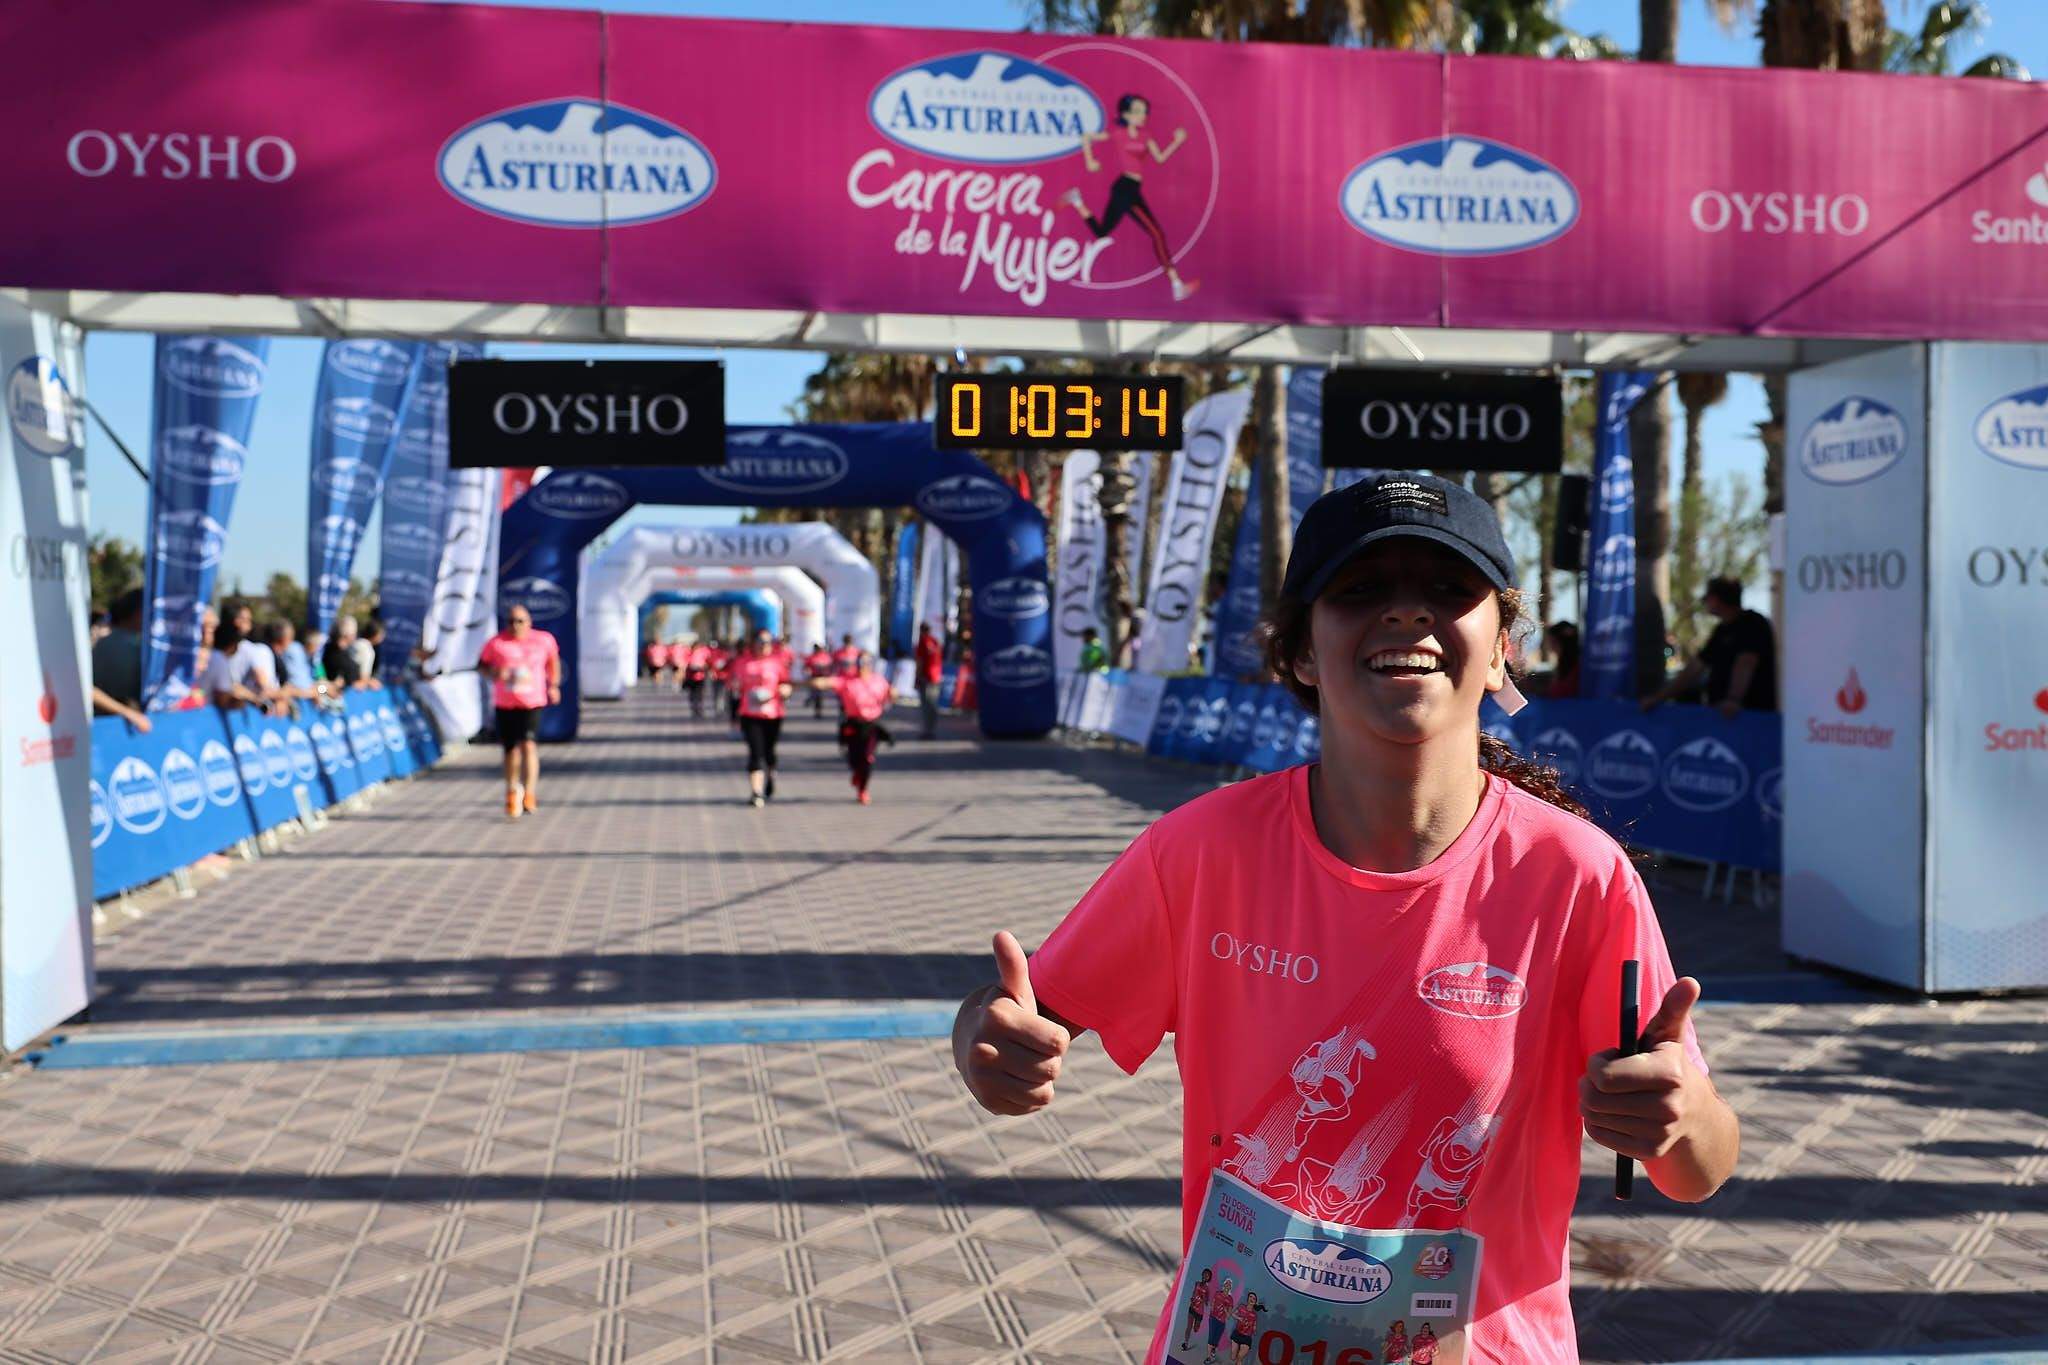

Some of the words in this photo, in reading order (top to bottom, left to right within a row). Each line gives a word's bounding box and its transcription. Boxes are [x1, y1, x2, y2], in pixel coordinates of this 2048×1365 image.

[890, 89, 1085, 136] ASTURIANA
[66, 129, 297, 183] OYSHO
[462, 143, 693, 194] ASTURIANA
[847, 148, 1043, 216] Carrera
[1361, 178, 1558, 223] ASTURIANA
[894, 211, 934, 255] de
[939, 212, 967, 256] la
[1691, 191, 1869, 236] OYSHO
[1971, 209, 2048, 244] Sant
[959, 209, 1114, 307] Mujer
[493, 391, 690, 436] OYSHO
[1360, 400, 1531, 442] OYSHO
[1807, 434, 1899, 465] ASTURIANA
[671, 532, 791, 558] OYSHO
[1798, 548, 1906, 593] OYSHO
[1807, 718, 1893, 749] Santander
[1211, 932, 1319, 984] OYSHO
[1425, 979, 1521, 1006] ASTURIANA
[1218, 1203, 1254, 1235] SUMA
[1269, 1248, 1382, 1293] ASTURIANA
[1291, 1252, 1336, 1270] CENTRAL
[1338, 1264, 1382, 1275] LECHERA
[1421, 1246, 1449, 1266] 20
